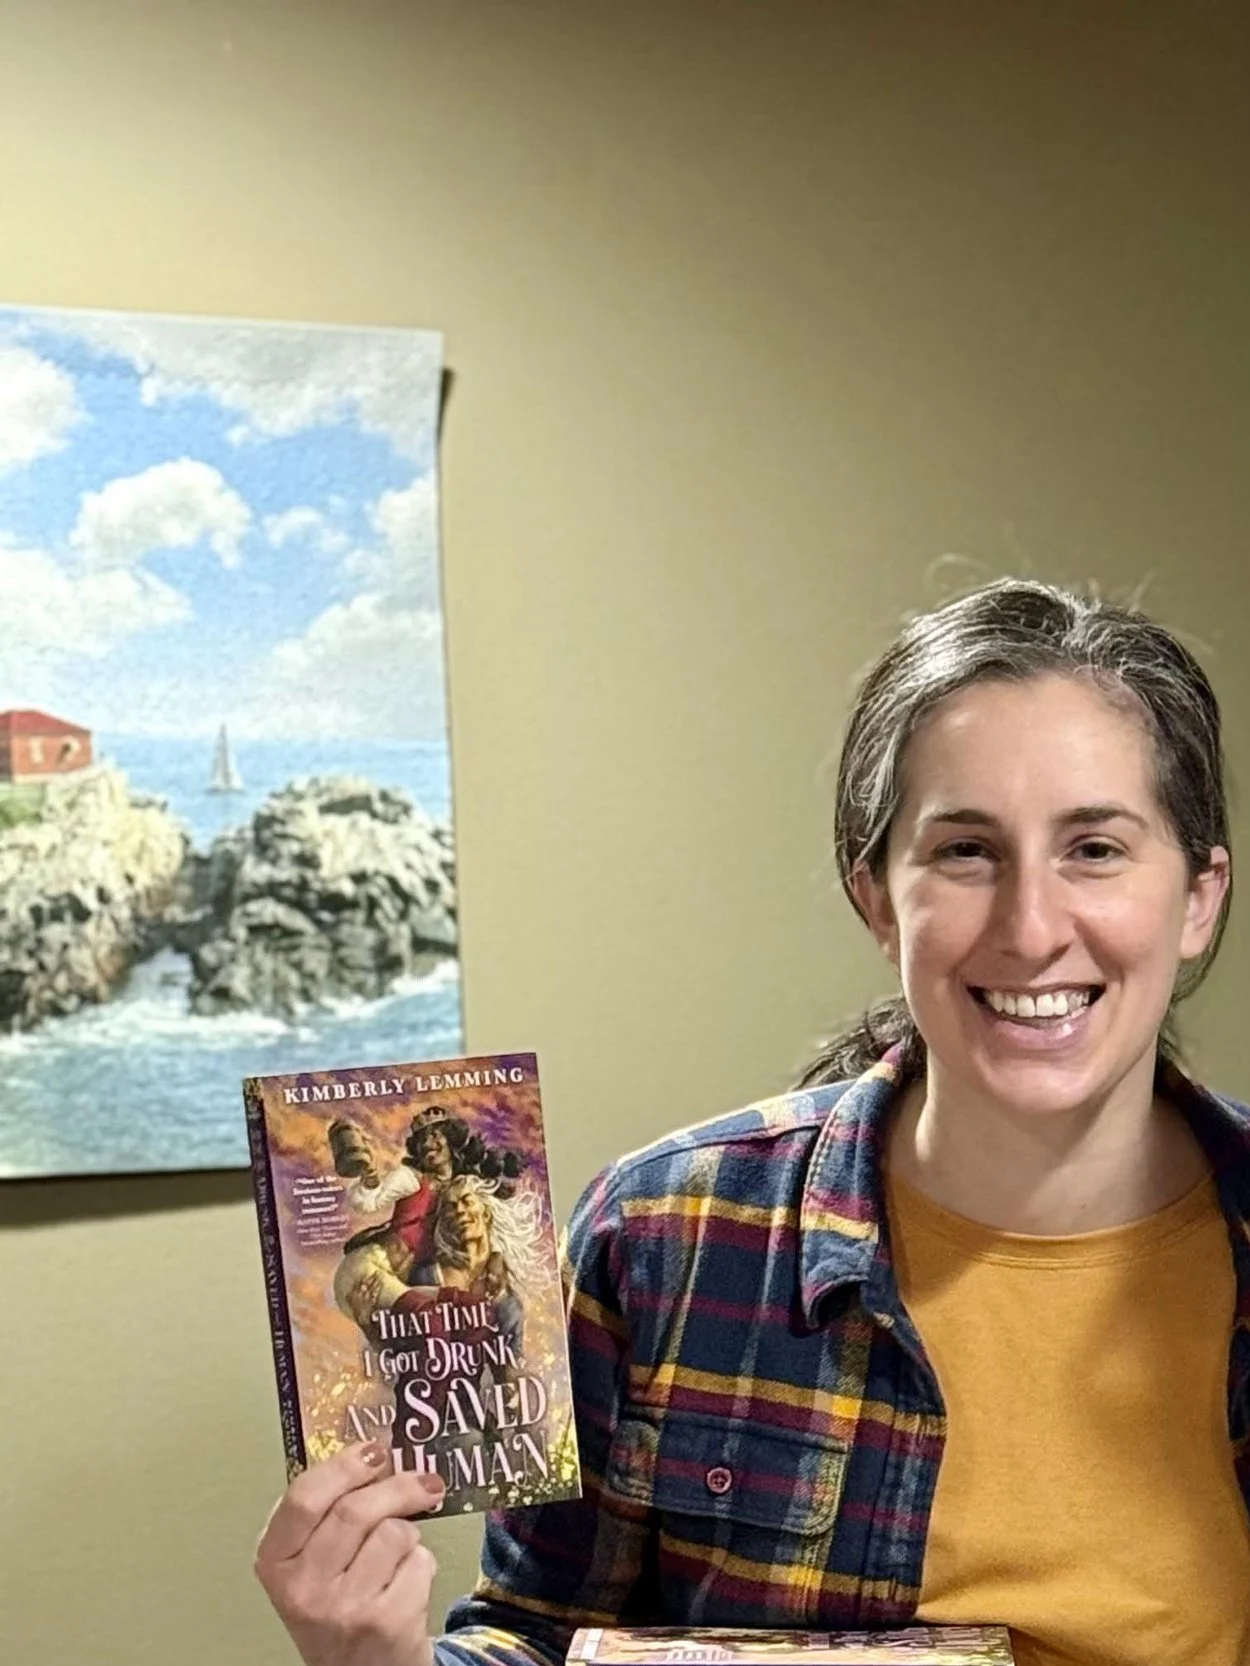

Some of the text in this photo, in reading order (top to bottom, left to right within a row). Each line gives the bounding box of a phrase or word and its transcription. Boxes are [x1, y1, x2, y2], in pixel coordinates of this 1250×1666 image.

[284, 1067, 524, 1104] KIMBERLY LEMMING
[372, 1300, 499, 1342] THAT TIME
[380, 1348, 420, 1384] GOT
[404, 1375, 547, 1443] SAVED
